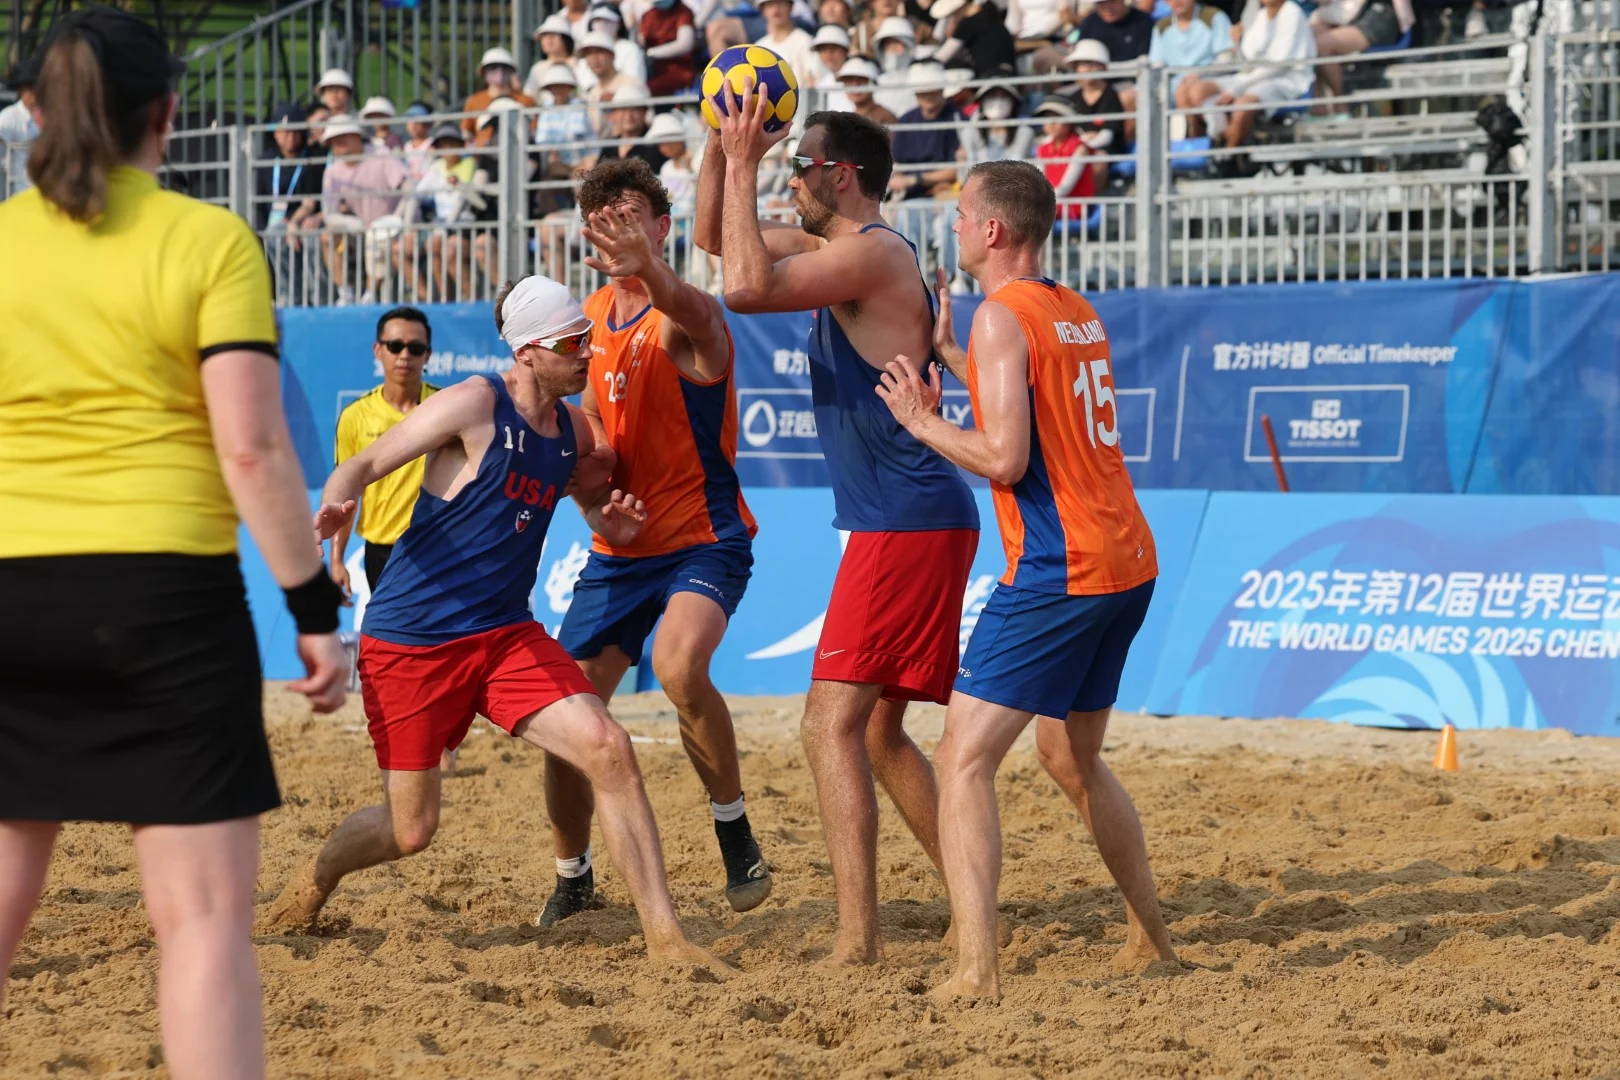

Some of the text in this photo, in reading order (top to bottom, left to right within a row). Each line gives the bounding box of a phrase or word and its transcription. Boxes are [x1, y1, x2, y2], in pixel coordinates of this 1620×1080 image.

[1213, 341, 1458, 371] 官方计时器 Official Timekeeper
[604, 371, 627, 403] 23
[1073, 359, 1118, 449] 15
[504, 425, 526, 454] 11
[1289, 419, 1362, 439] TISSOT
[504, 471, 556, 512] USA
[688, 578, 720, 592] CRAFT
[1227, 619, 1276, 649] THE
[1278, 620, 1373, 652] WORLD
[1373, 622, 1470, 655] GAMES
[1470, 625, 1545, 657] 2025
